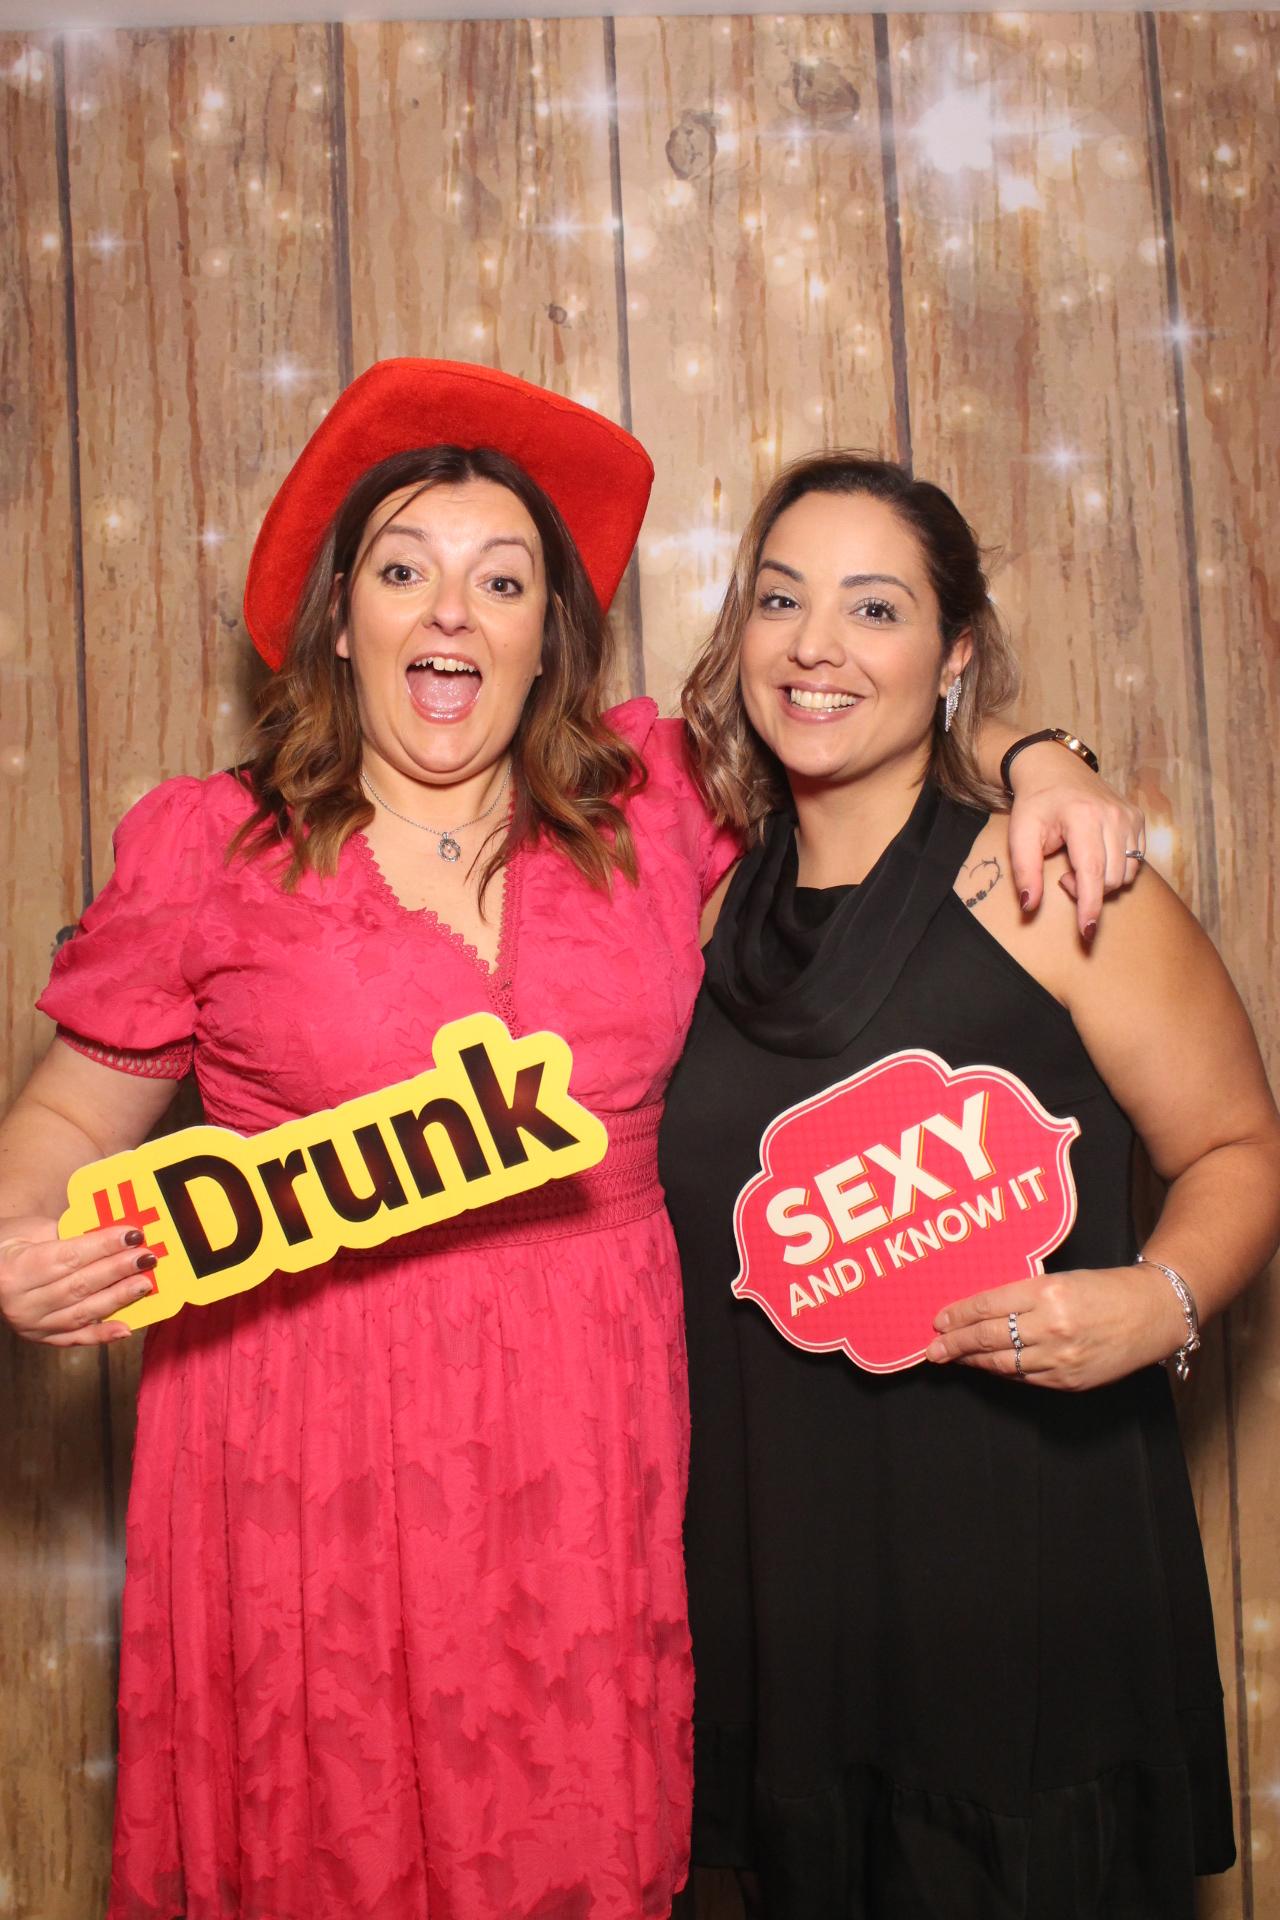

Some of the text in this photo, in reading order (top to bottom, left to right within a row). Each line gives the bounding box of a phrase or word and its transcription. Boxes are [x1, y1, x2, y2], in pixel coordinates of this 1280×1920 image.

[766, 1091, 995, 1266] SEXY
[789, 1167, 1048, 1317] AND I KNOW IT
